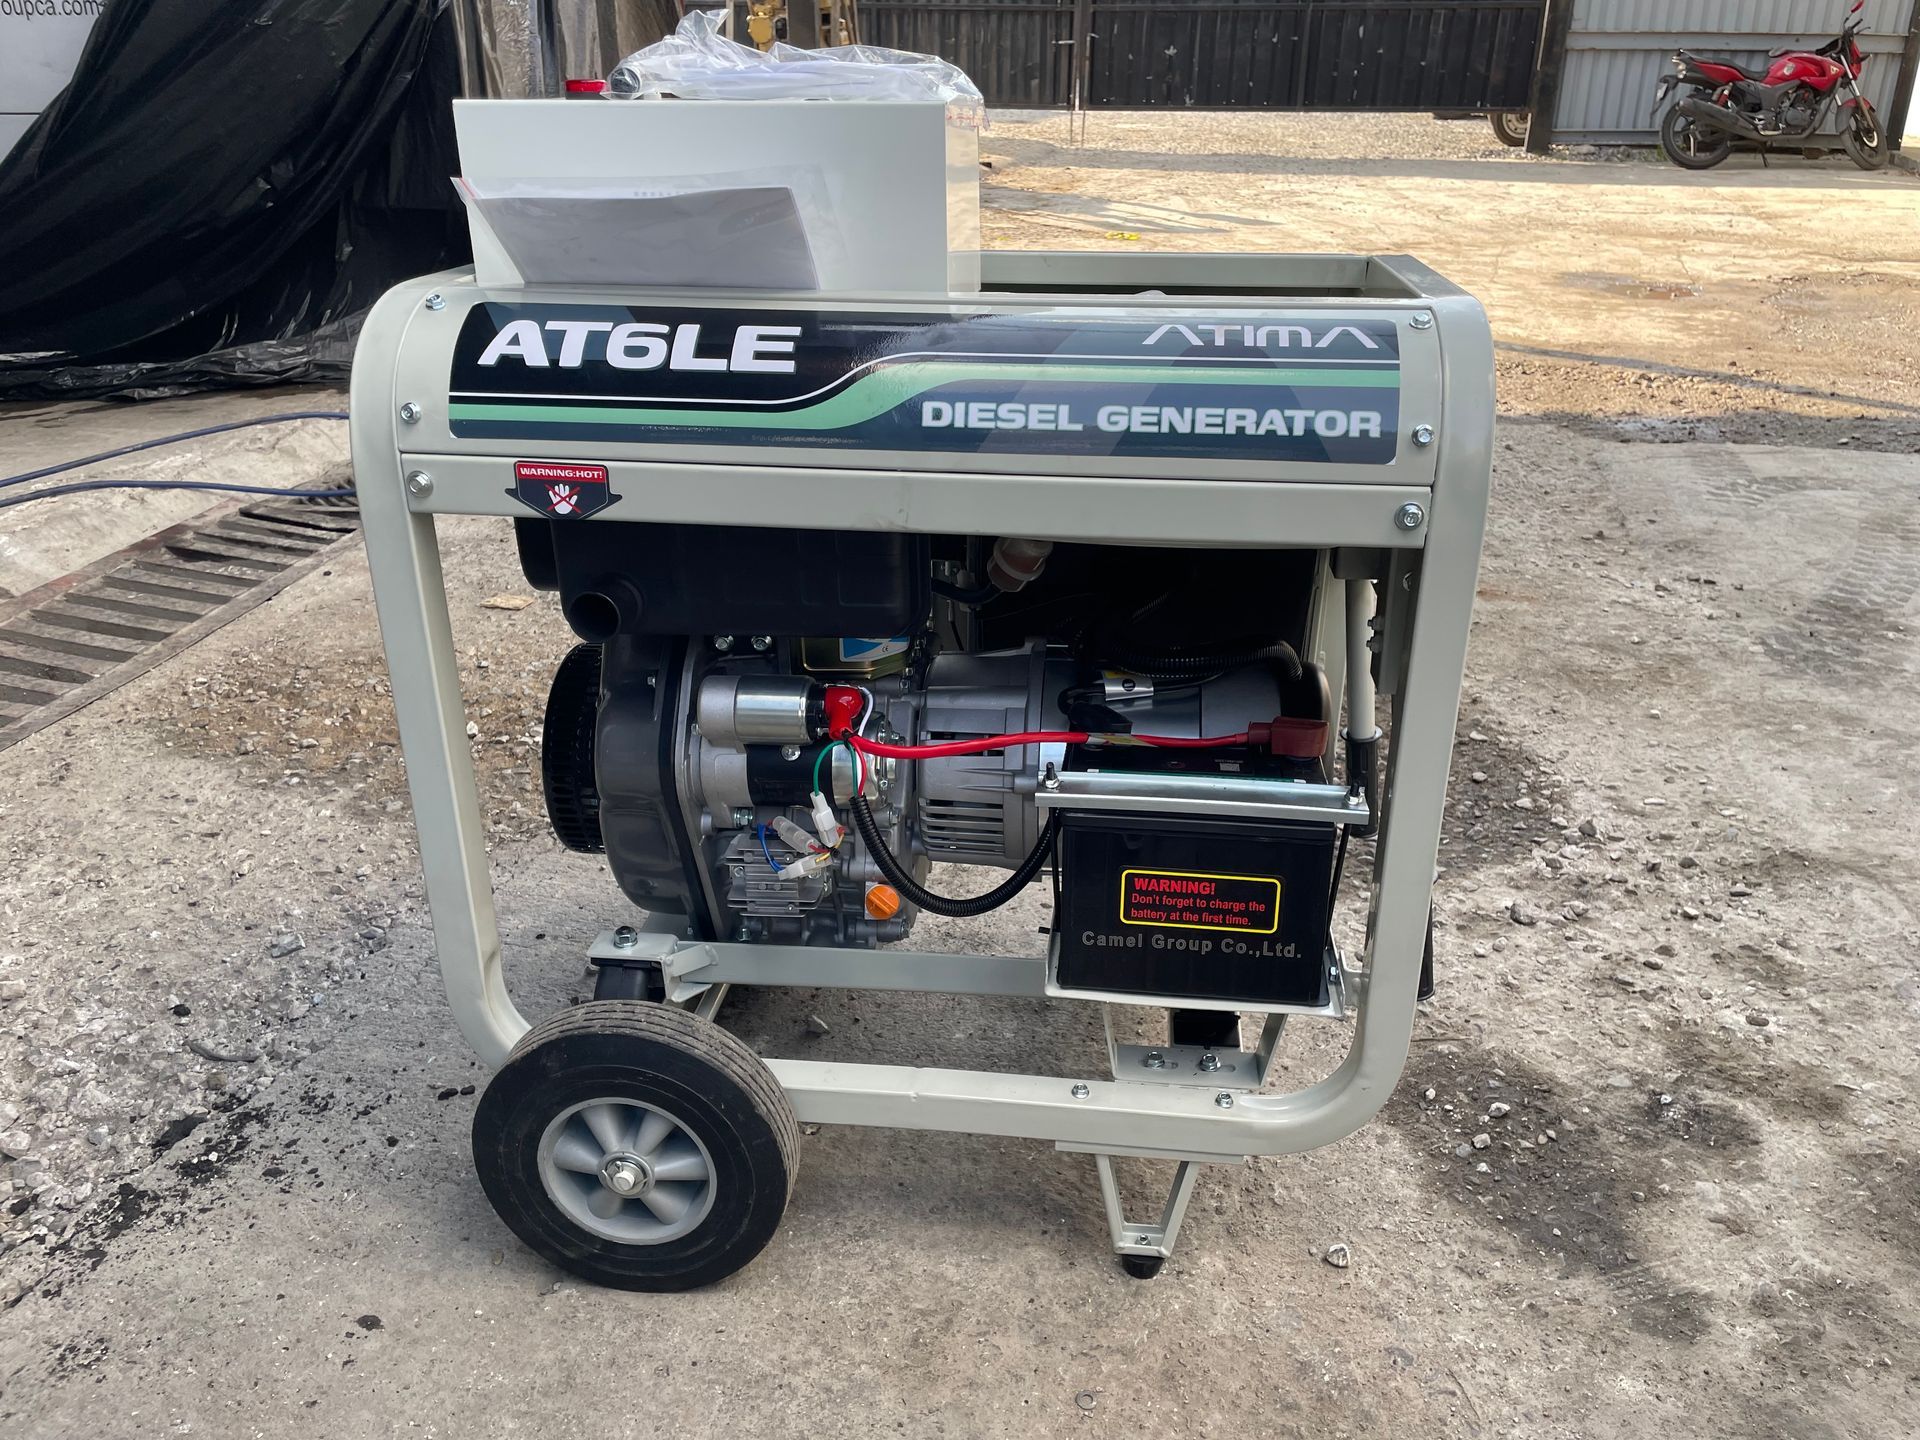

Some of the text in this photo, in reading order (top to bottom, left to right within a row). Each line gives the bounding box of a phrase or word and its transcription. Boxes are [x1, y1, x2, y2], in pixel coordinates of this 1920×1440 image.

[477, 319, 801, 374] AT6LE
[1142, 324, 1379, 349] ATIMA
[921, 400, 1381, 439] DIESEL GENERATOR
[520, 467, 603, 479] WARNING:HOT!
[1134, 877, 1216, 895] WARNING!
[1131, 893, 1266, 912] Don't forget to charge the
[1131, 908, 1251, 926] battery at the first time.
[1081, 930, 1143, 948] Camel
[1151, 934, 1213, 955] Group
